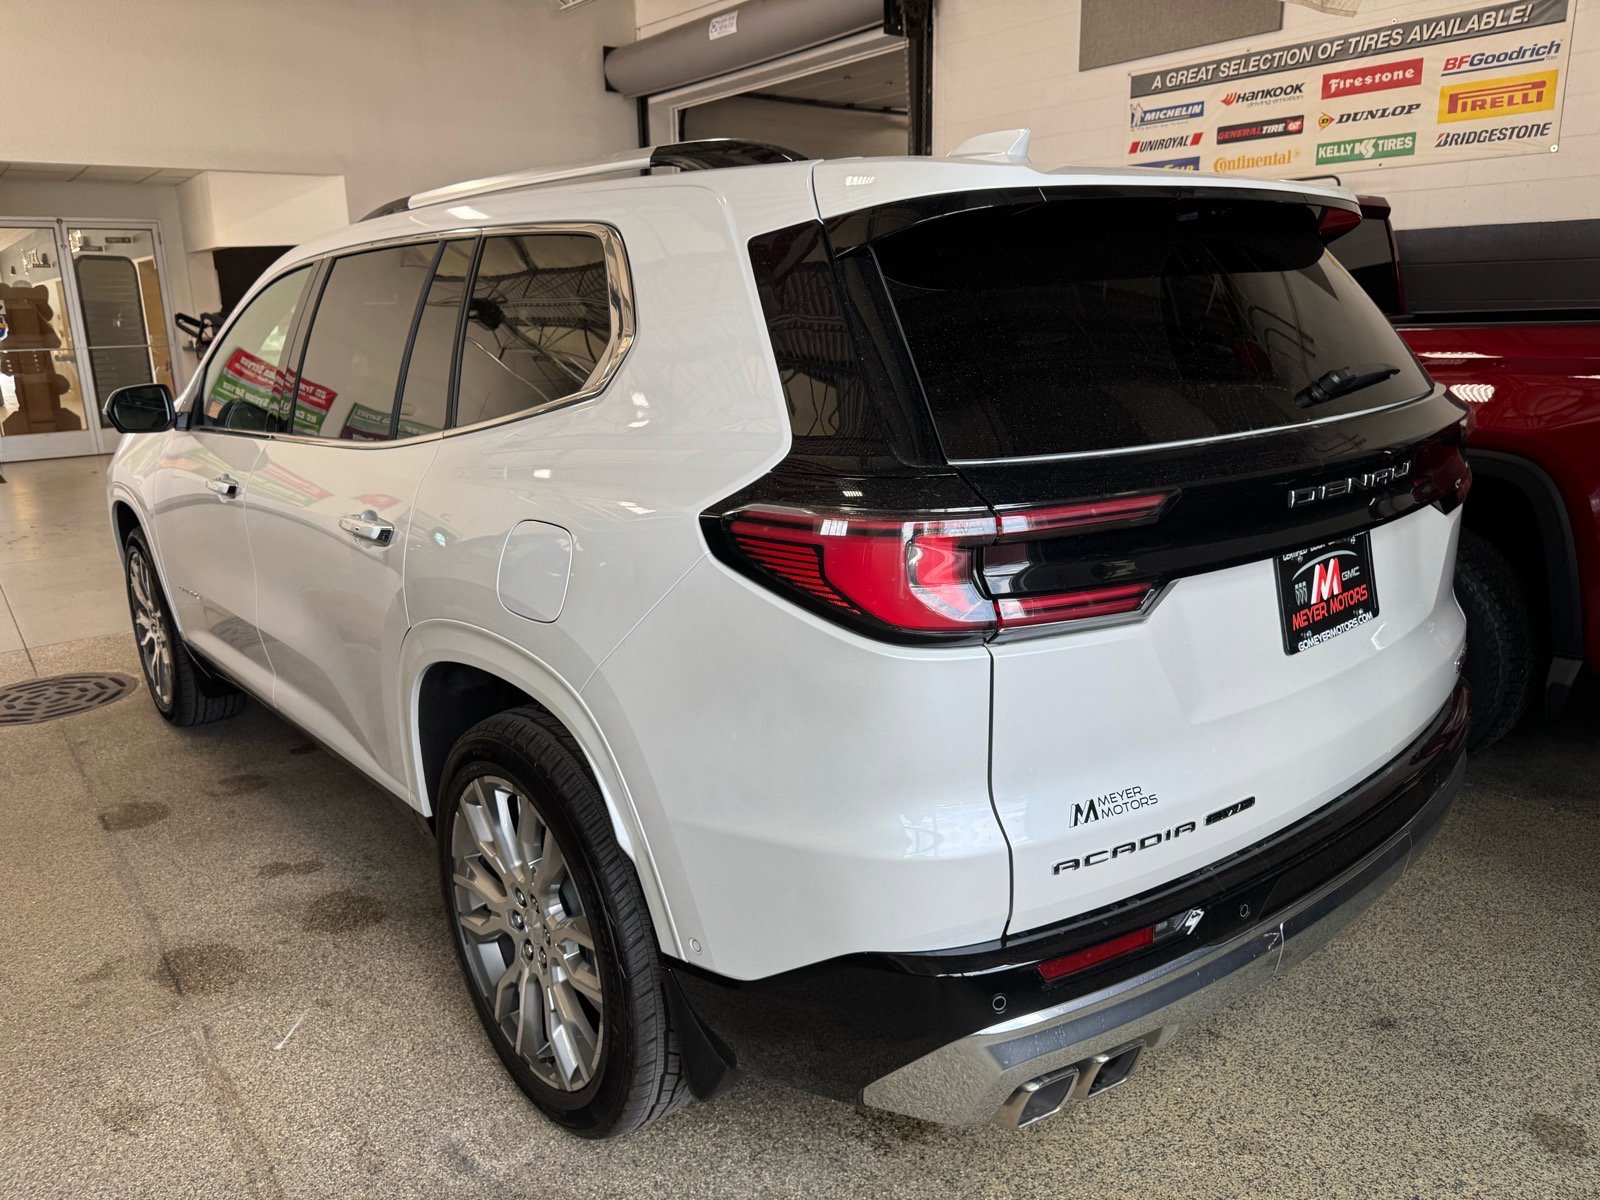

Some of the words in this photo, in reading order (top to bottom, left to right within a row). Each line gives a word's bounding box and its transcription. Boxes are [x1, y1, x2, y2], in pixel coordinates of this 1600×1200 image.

[1151, 74, 1162, 91] A
[1166, 64, 1216, 88] GREAT
[1218, 46, 1313, 77] SELECTION
[1317, 42, 1345, 60] OF
[1347, 28, 1404, 54] TIRES
[1406, 5, 1534, 43] AVAILABLE!
[1443, 40, 1562, 72] BFGoodrich
[1329, 67, 1415, 93] Firestone
[1272, 94, 1305, 106] emotion
[1447, 80, 1547, 114] PIRELLI
[1144, 103, 1202, 122] MICHELIN
[1336, 103, 1422, 124] DUNLOP
[1139, 135, 1190, 153] UNIROYAL
[1318, 142, 1353, 159] KELLY
[1376, 136, 1414, 151] TIRES
[1435, 122, 1553, 148] BRIDGESTONE
[1213, 150, 1292, 173] Continental
[1341, 566, 1360, 581] GMC
[1292, 602, 1328, 631] MEYER
[1329, 584, 1368, 615] MOTORS
[1297, 610, 1374, 652] GOMEYERMOTORS.COM
[1097, 785, 1143, 807] MEYER
[1101, 793, 1159, 820] MOTORS
[1051, 820, 1196, 876] ACADIA
